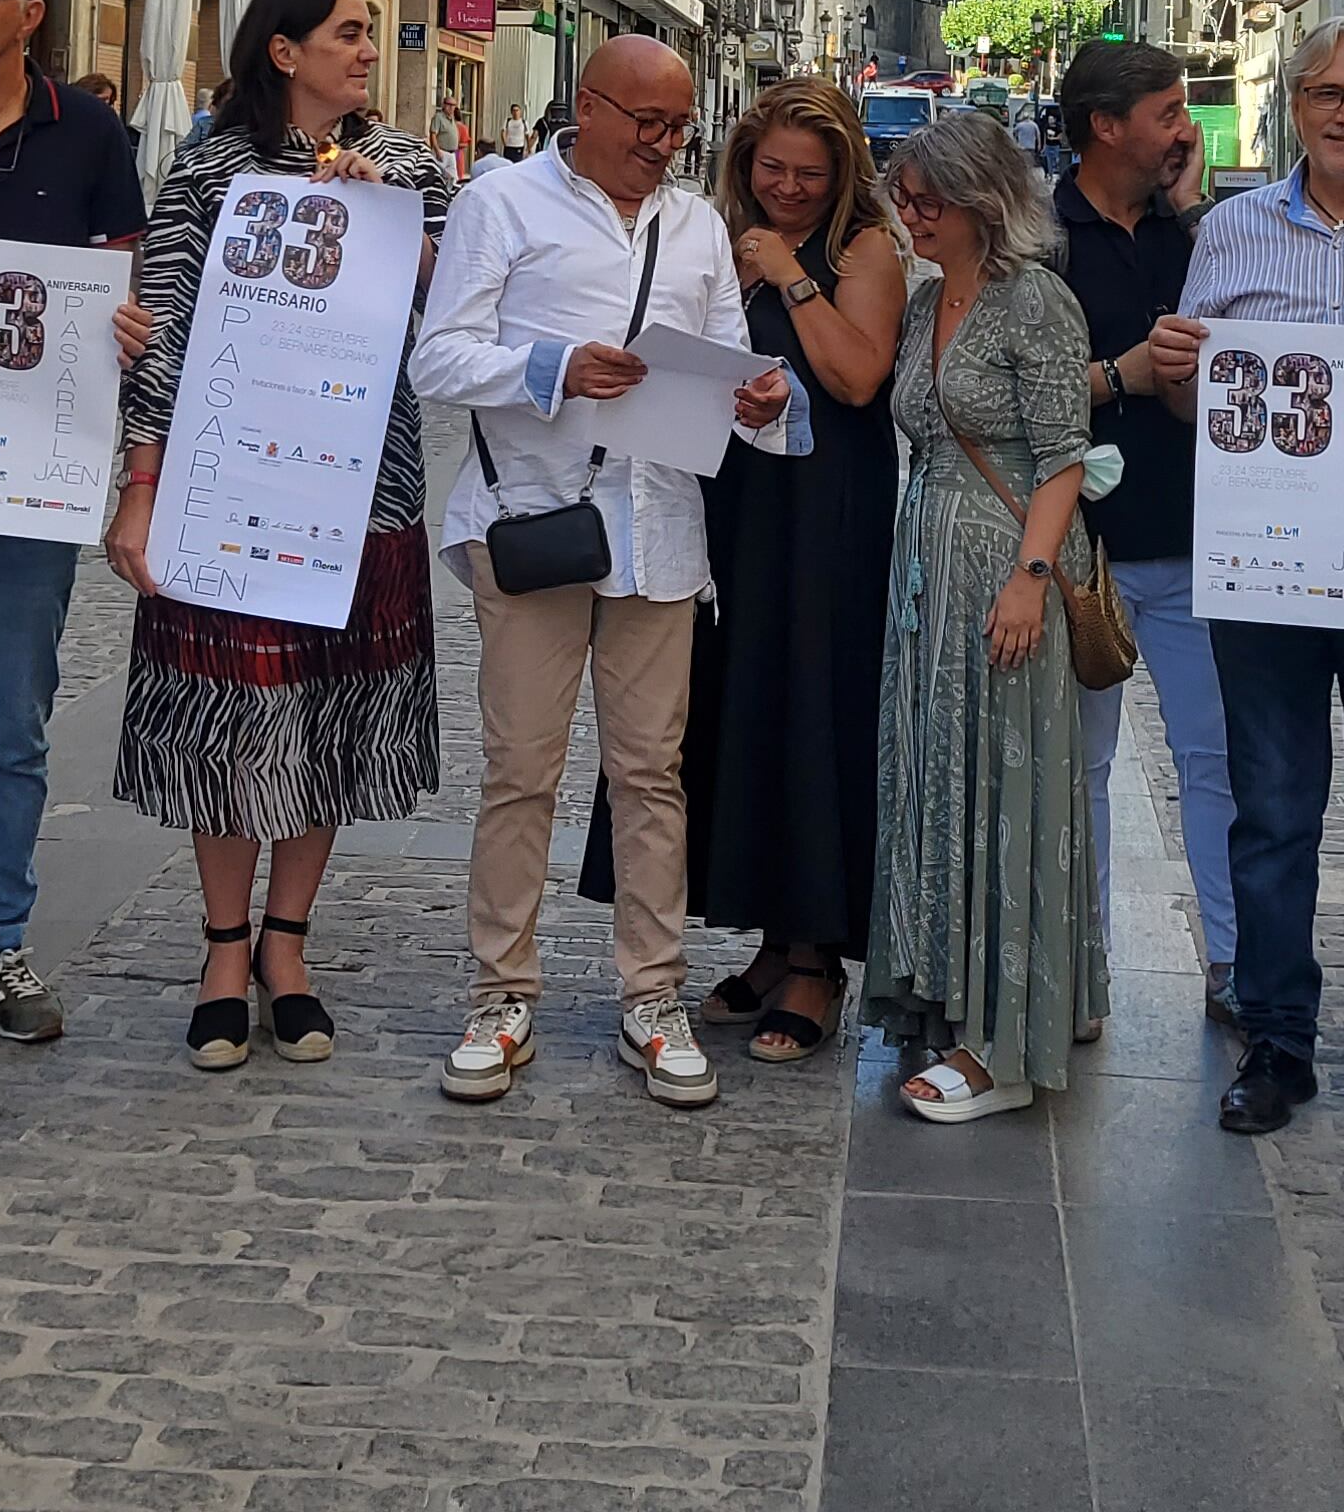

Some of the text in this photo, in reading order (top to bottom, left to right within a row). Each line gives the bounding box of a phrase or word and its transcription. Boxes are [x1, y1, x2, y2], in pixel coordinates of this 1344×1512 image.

[222, 191, 349, 290] 33
[46, 280, 111, 294] ANIVERSARIO
[219, 281, 327, 313] ANIVERSARIO
[321, 380, 367, 400] DOWN
[1208, 350, 1333, 457] 33
[34, 460, 100, 487] JAÉN
[1266, 525, 1299, 537] DOWN
[156, 560, 248, 601] JAÉN
